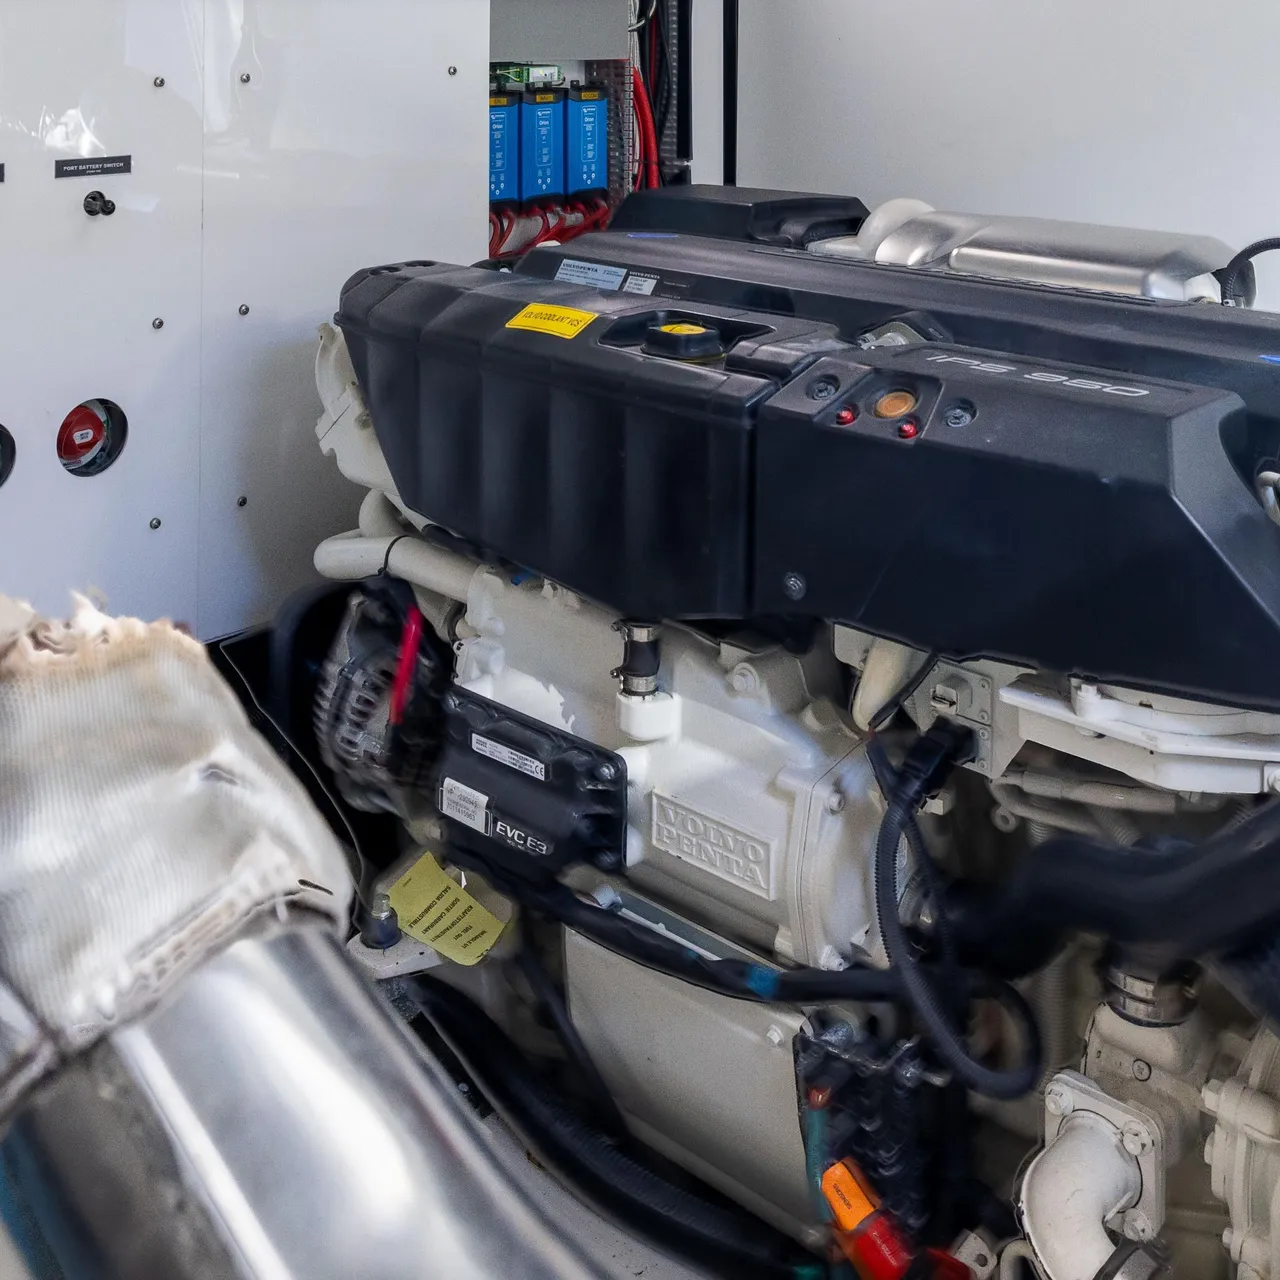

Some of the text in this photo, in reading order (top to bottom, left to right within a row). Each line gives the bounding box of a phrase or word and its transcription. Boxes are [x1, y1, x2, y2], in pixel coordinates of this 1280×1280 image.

[579, 265, 598, 273] PENTA
[522, 311, 540, 319] VOLVO
[539, 312, 570, 324] COOLANT
[925, 355, 1150, 397] IPS 950
[496, 821, 525, 844] EVC
[526, 836, 547, 855] E3
[659, 801, 765, 863] VOLVO
[657, 821, 768, 890] PENTA
[408, 885, 452, 929] SALIDA COMBUSTIBLE
[421, 897, 461, 935] SORTIE CARBURANT
[453, 925, 473, 940] FUEL OUT
[832, 1183, 853, 1210] SENSORS
